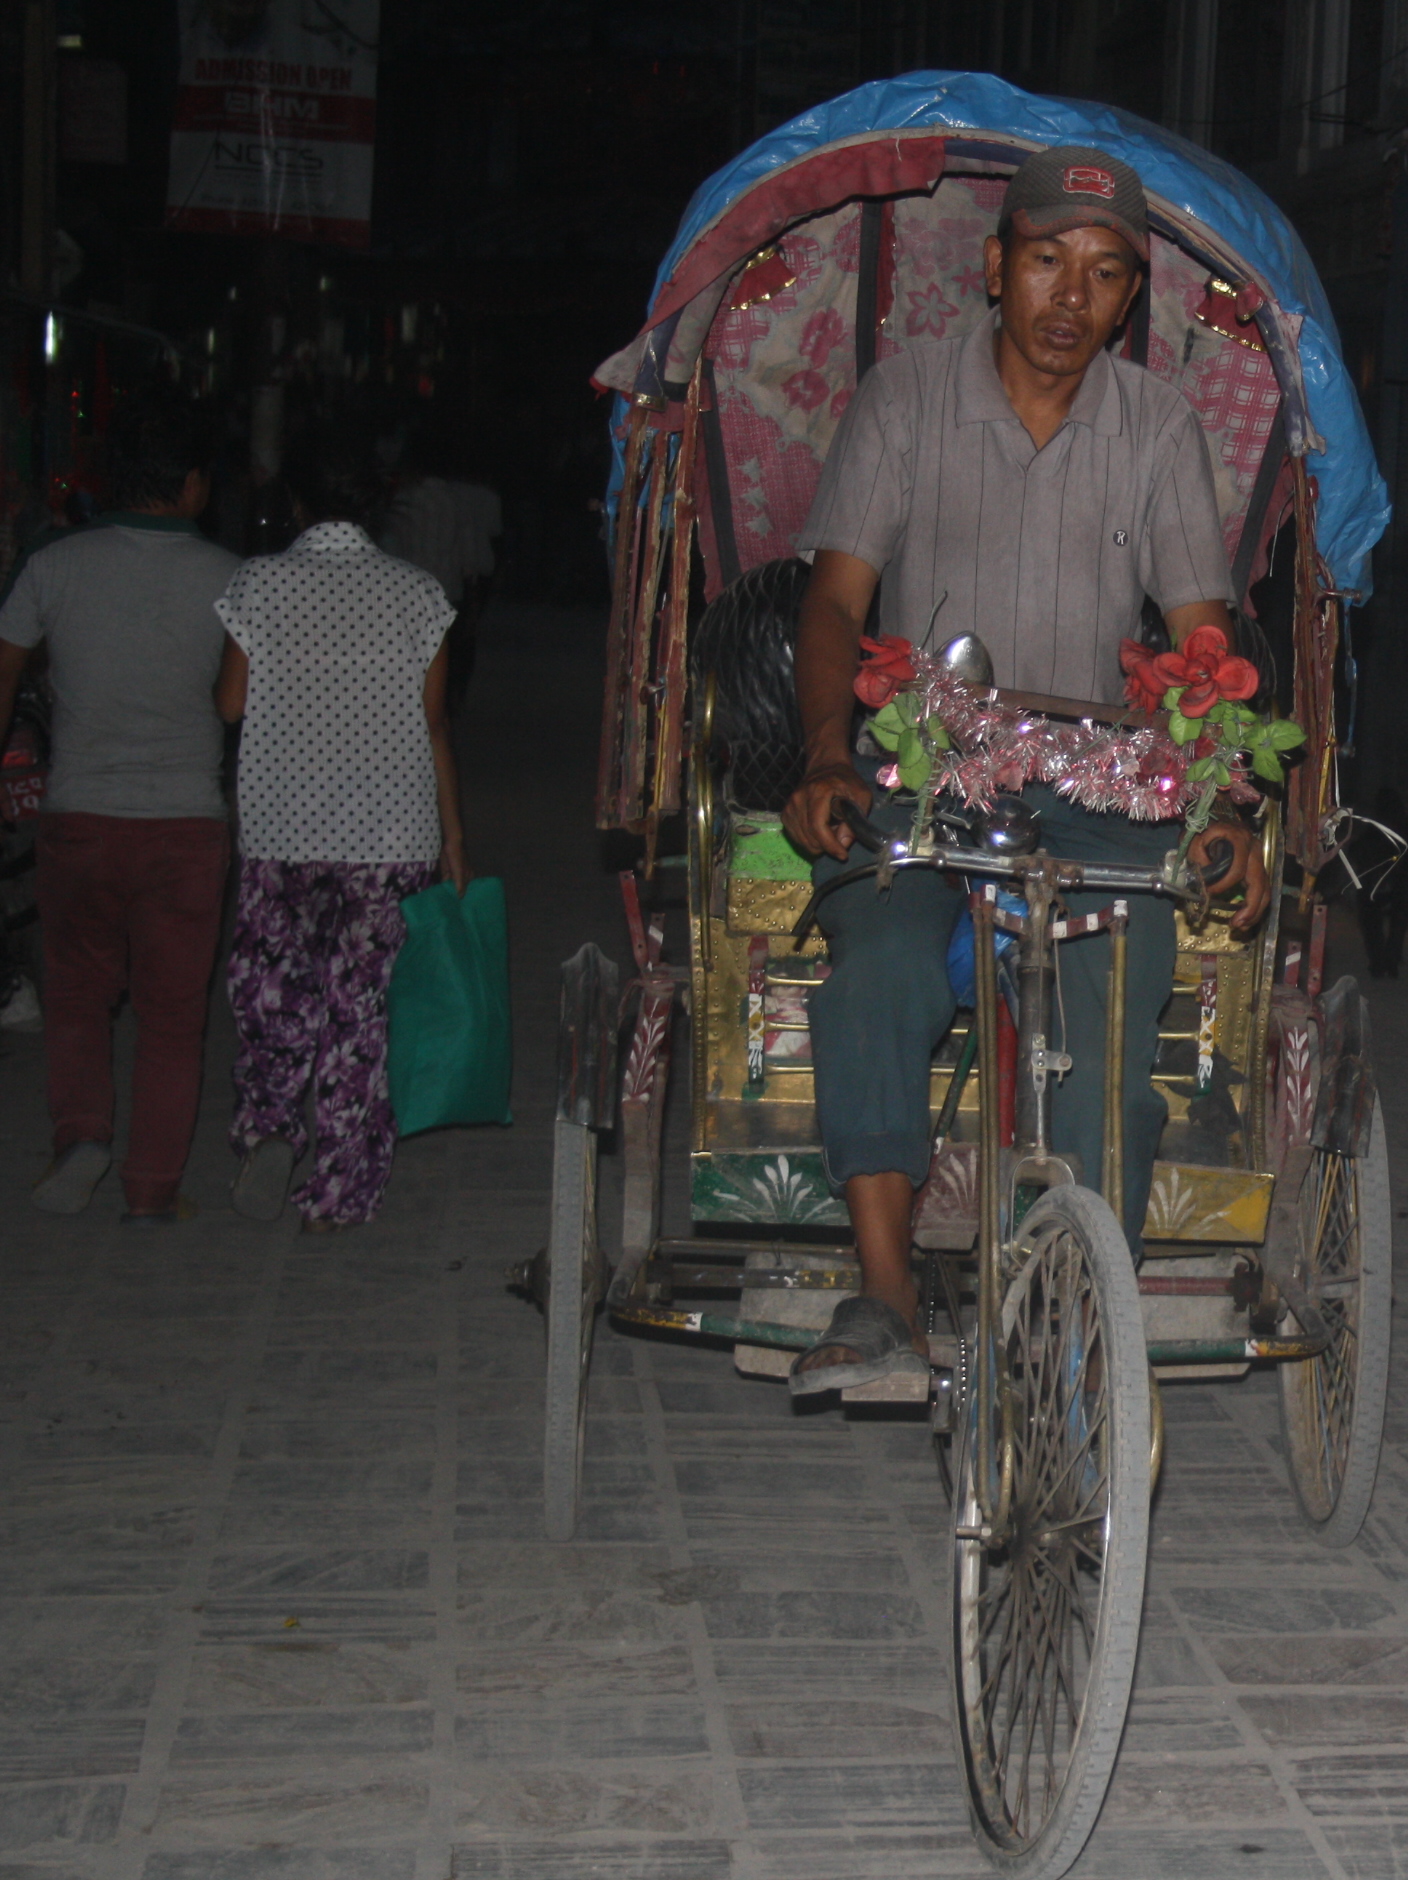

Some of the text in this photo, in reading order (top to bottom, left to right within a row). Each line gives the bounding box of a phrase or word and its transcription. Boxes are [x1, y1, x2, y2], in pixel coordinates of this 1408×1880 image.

[196, 58, 352, 90] ADMISSION OPEN
[223, 92, 321, 121] BHM
[214, 140, 324, 171] NCCS
